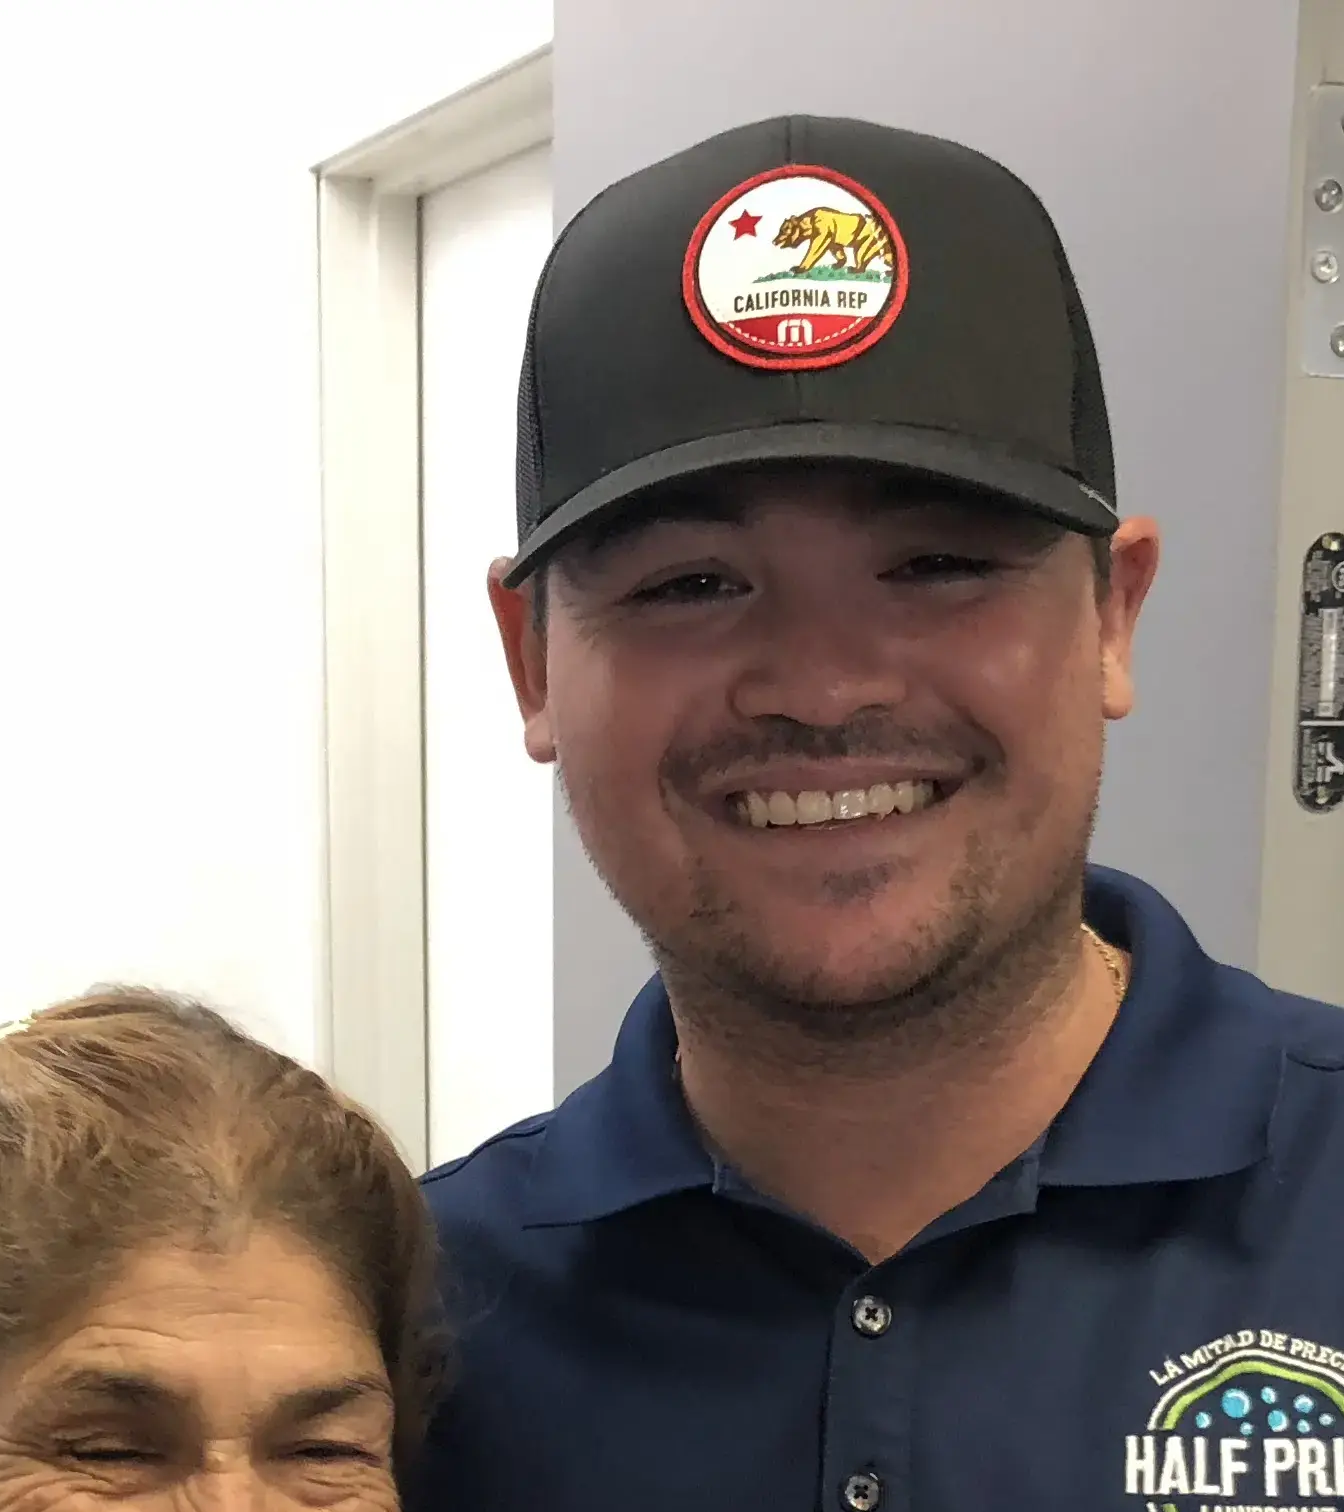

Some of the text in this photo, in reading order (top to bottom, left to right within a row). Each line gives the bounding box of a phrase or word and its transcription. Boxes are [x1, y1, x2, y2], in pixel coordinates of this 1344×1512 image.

[733, 289, 868, 313] CALIFORNIA REP
[1149, 1359, 1184, 1386] LA
[1183, 1329, 1256, 1370] MITAD
[1258, 1329, 1288, 1352] DE
[1124, 1435, 1250, 1497] HALF
